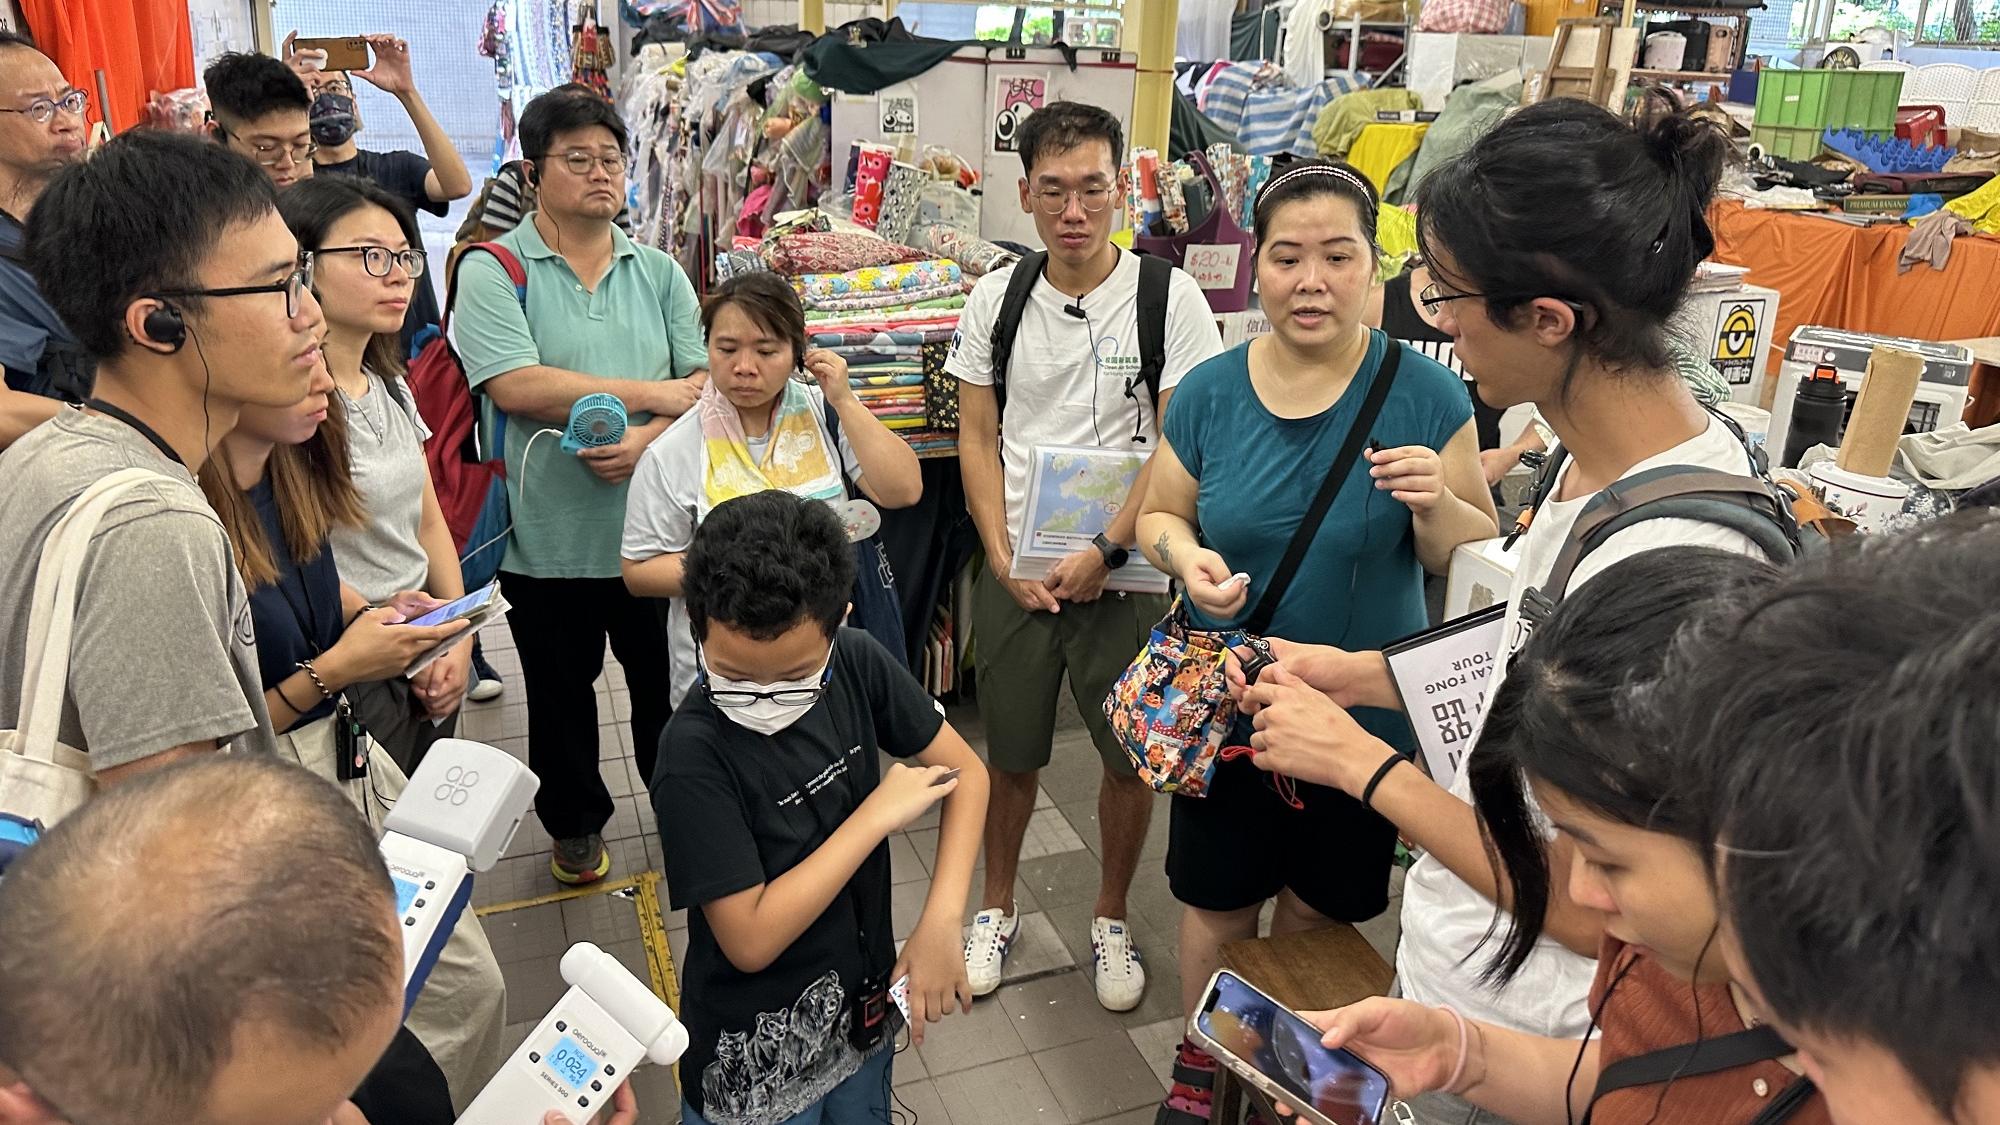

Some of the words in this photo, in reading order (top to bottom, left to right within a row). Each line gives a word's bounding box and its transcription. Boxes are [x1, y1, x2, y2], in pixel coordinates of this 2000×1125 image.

[1849, 201, 1878, 209] PREMIUM
[1451, 651, 1493, 671] TOUR
[1424, 674, 1467, 694] FONG
[556, 1049, 588, 1079] 0.024
[540, 1071, 559, 1089] SERIES
[557, 1086, 569, 1098] 500
